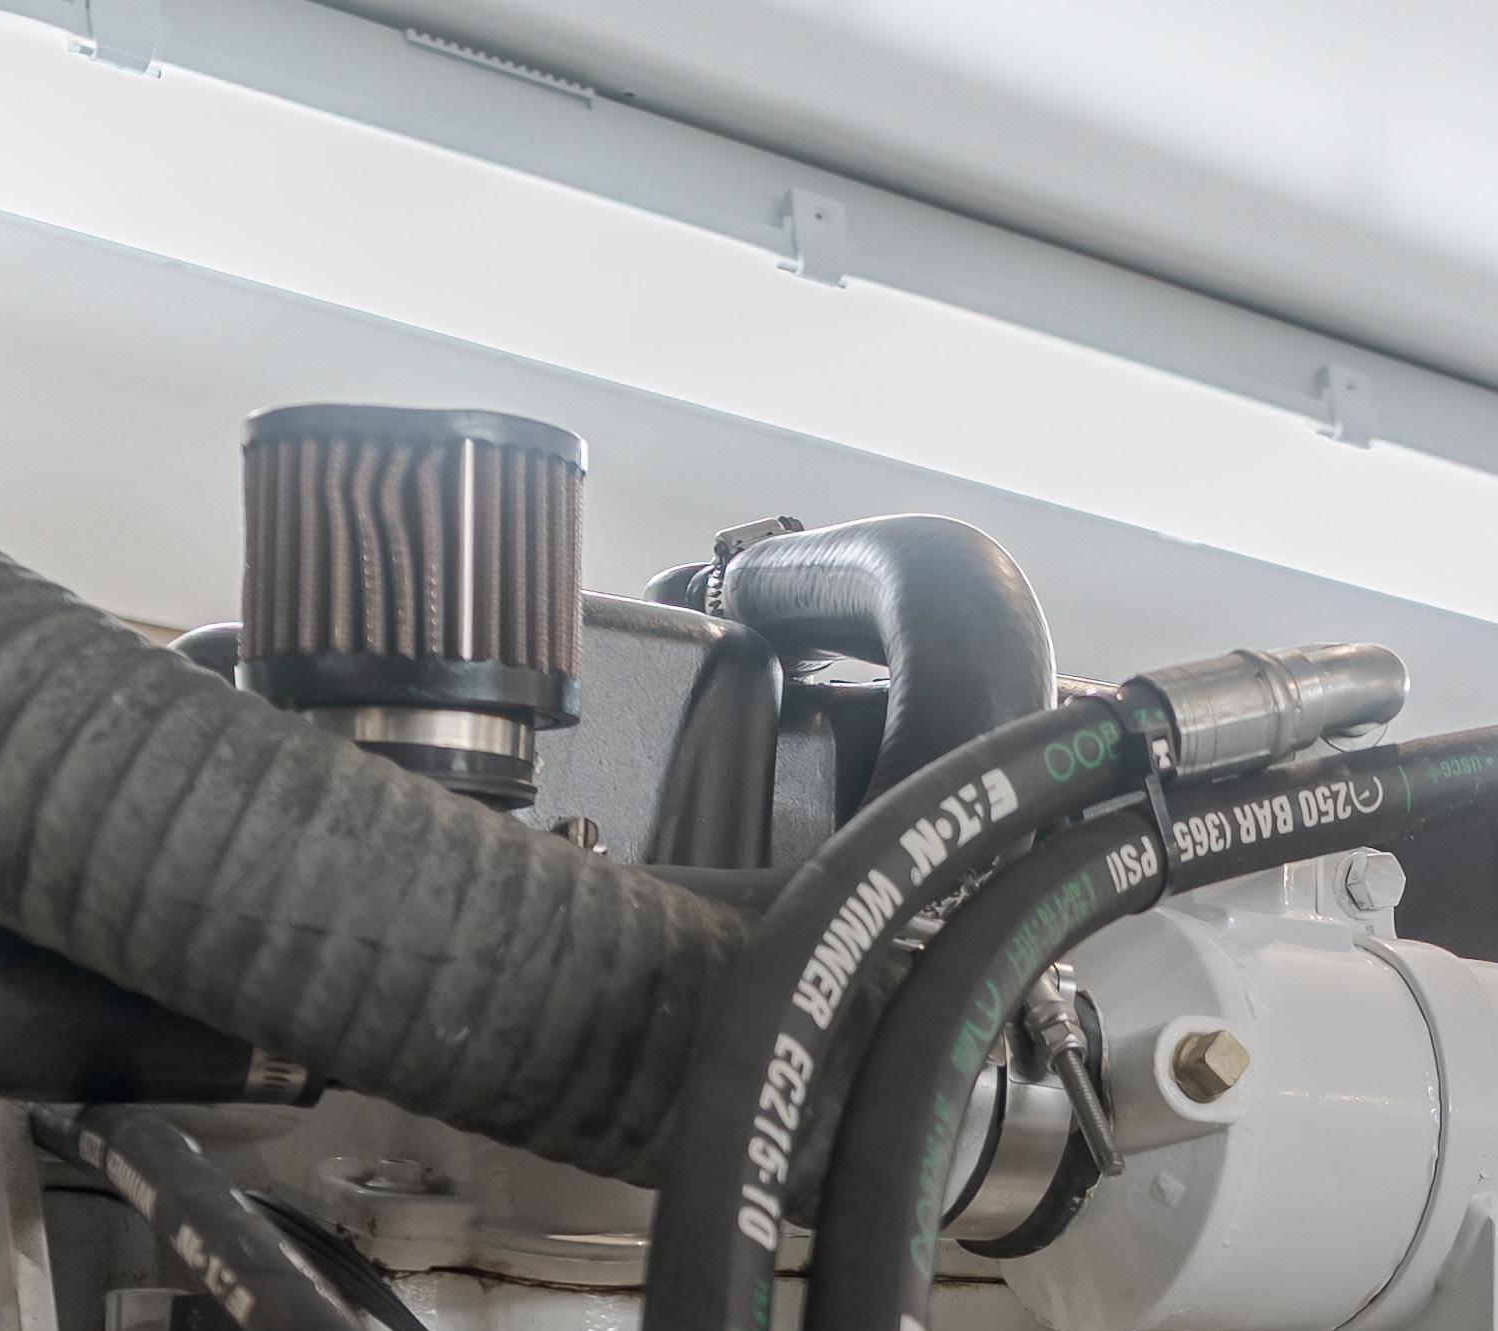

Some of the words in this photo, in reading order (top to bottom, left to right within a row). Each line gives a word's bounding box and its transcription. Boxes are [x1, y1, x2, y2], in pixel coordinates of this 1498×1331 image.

[1238, 794, 1293, 845] BAR
[791, 869, 903, 1031] WINNER
[738, 1032, 815, 1251] EC215-10
